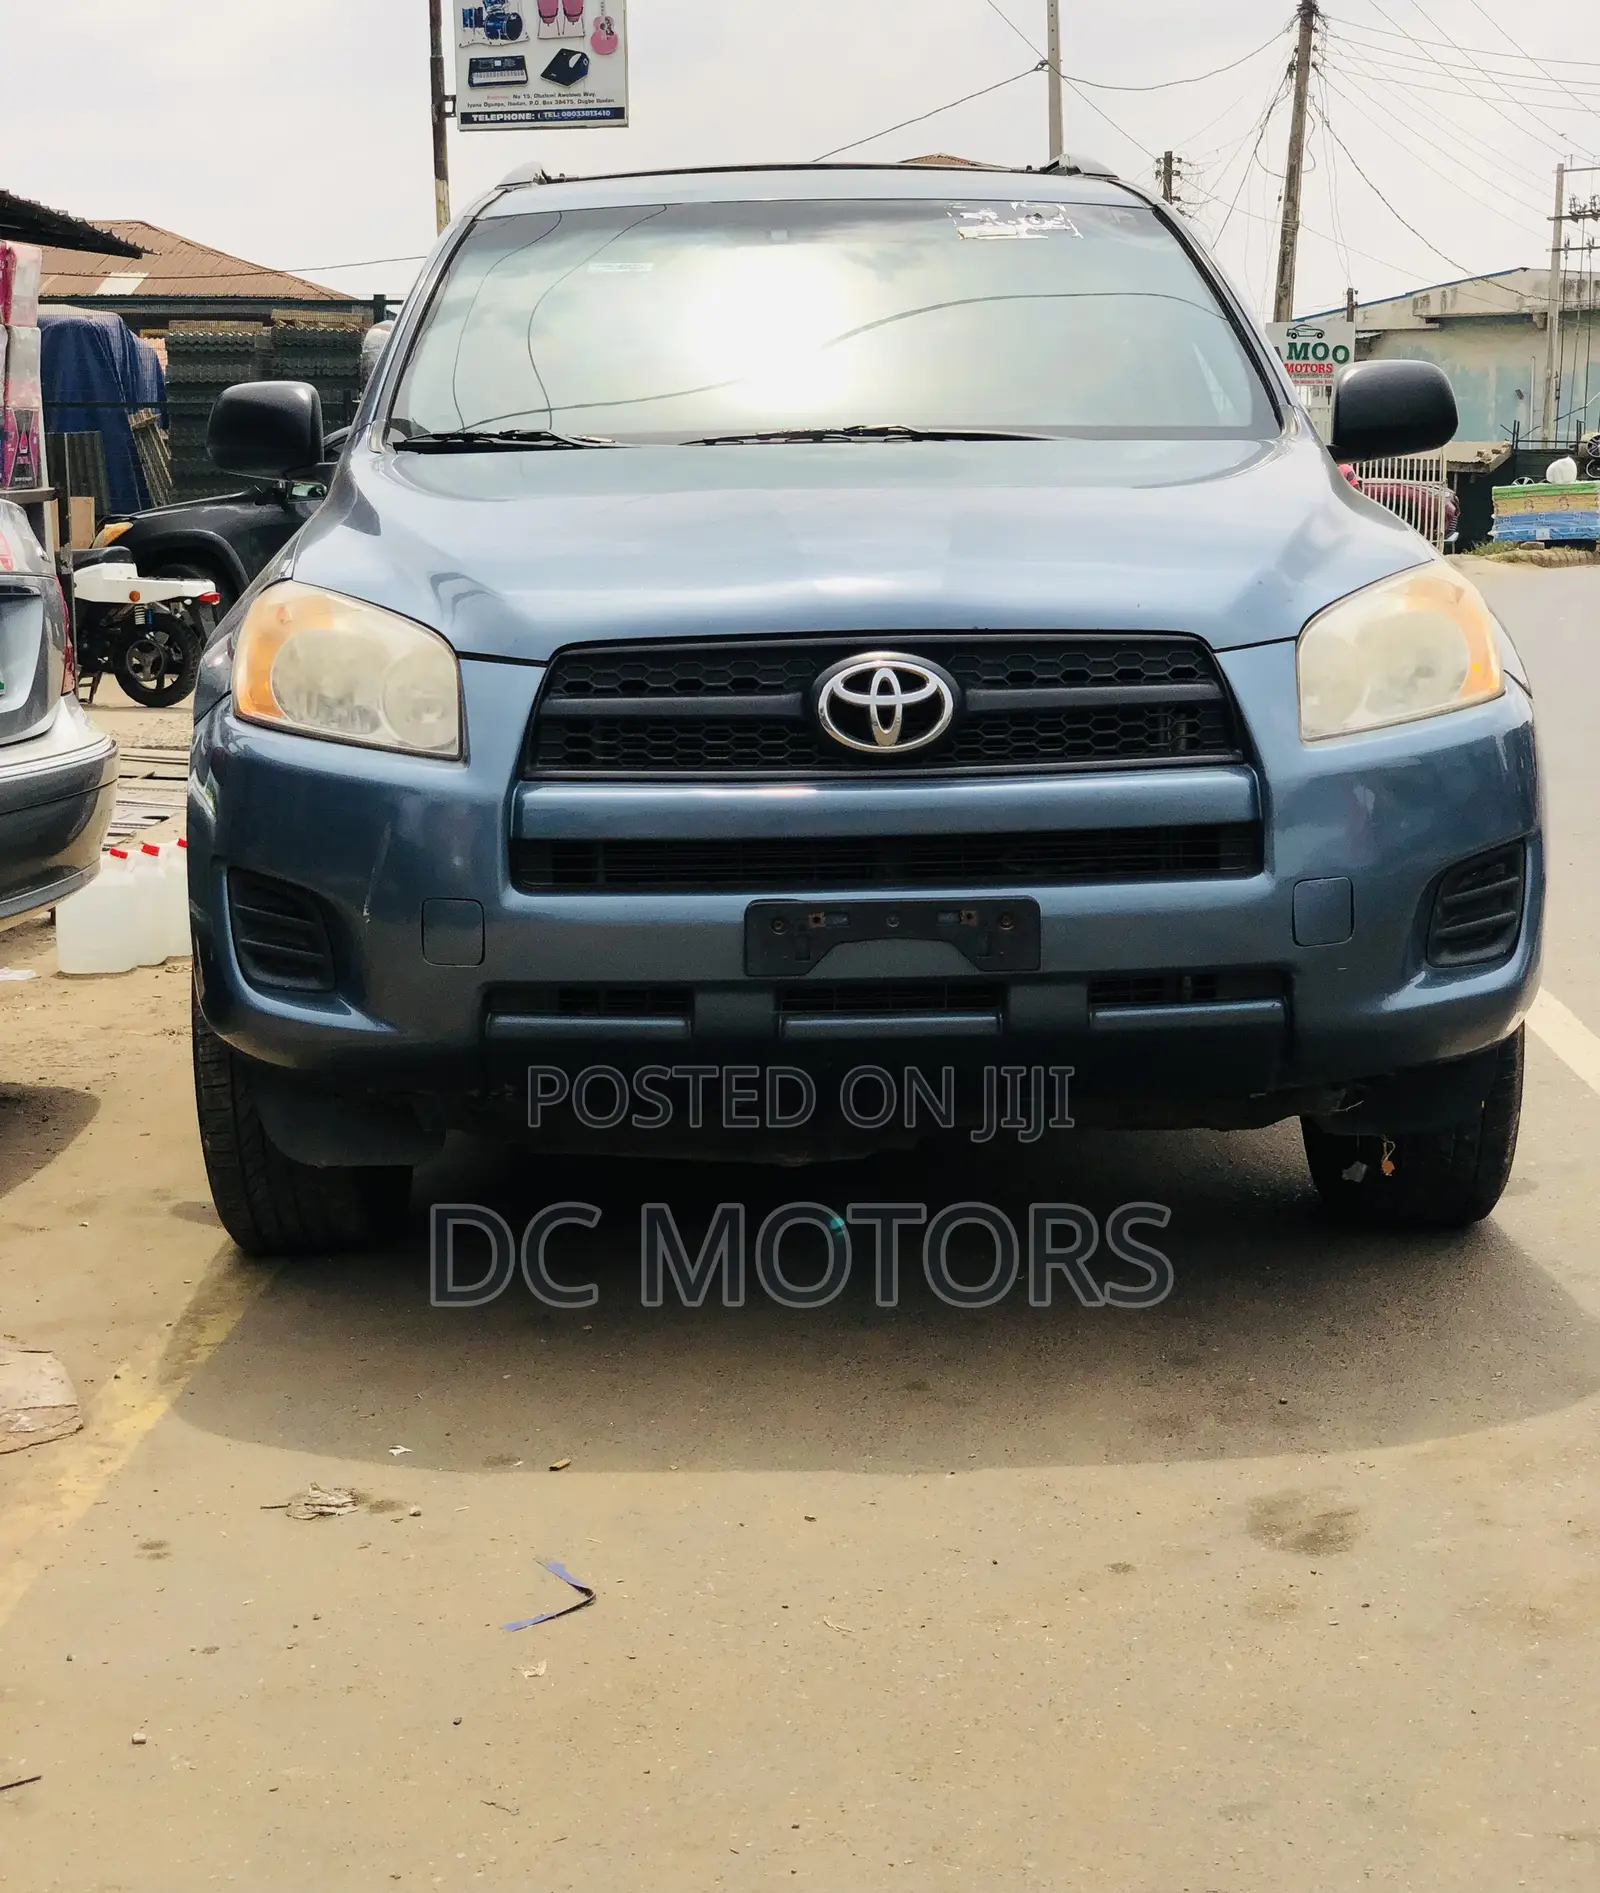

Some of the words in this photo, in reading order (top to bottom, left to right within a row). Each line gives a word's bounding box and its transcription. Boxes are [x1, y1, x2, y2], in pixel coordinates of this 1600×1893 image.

[471, 112, 535, 122] TELEPHONE:
[543, 111, 560, 119] TEL:
[1284, 362, 1334, 374] MOTORS
